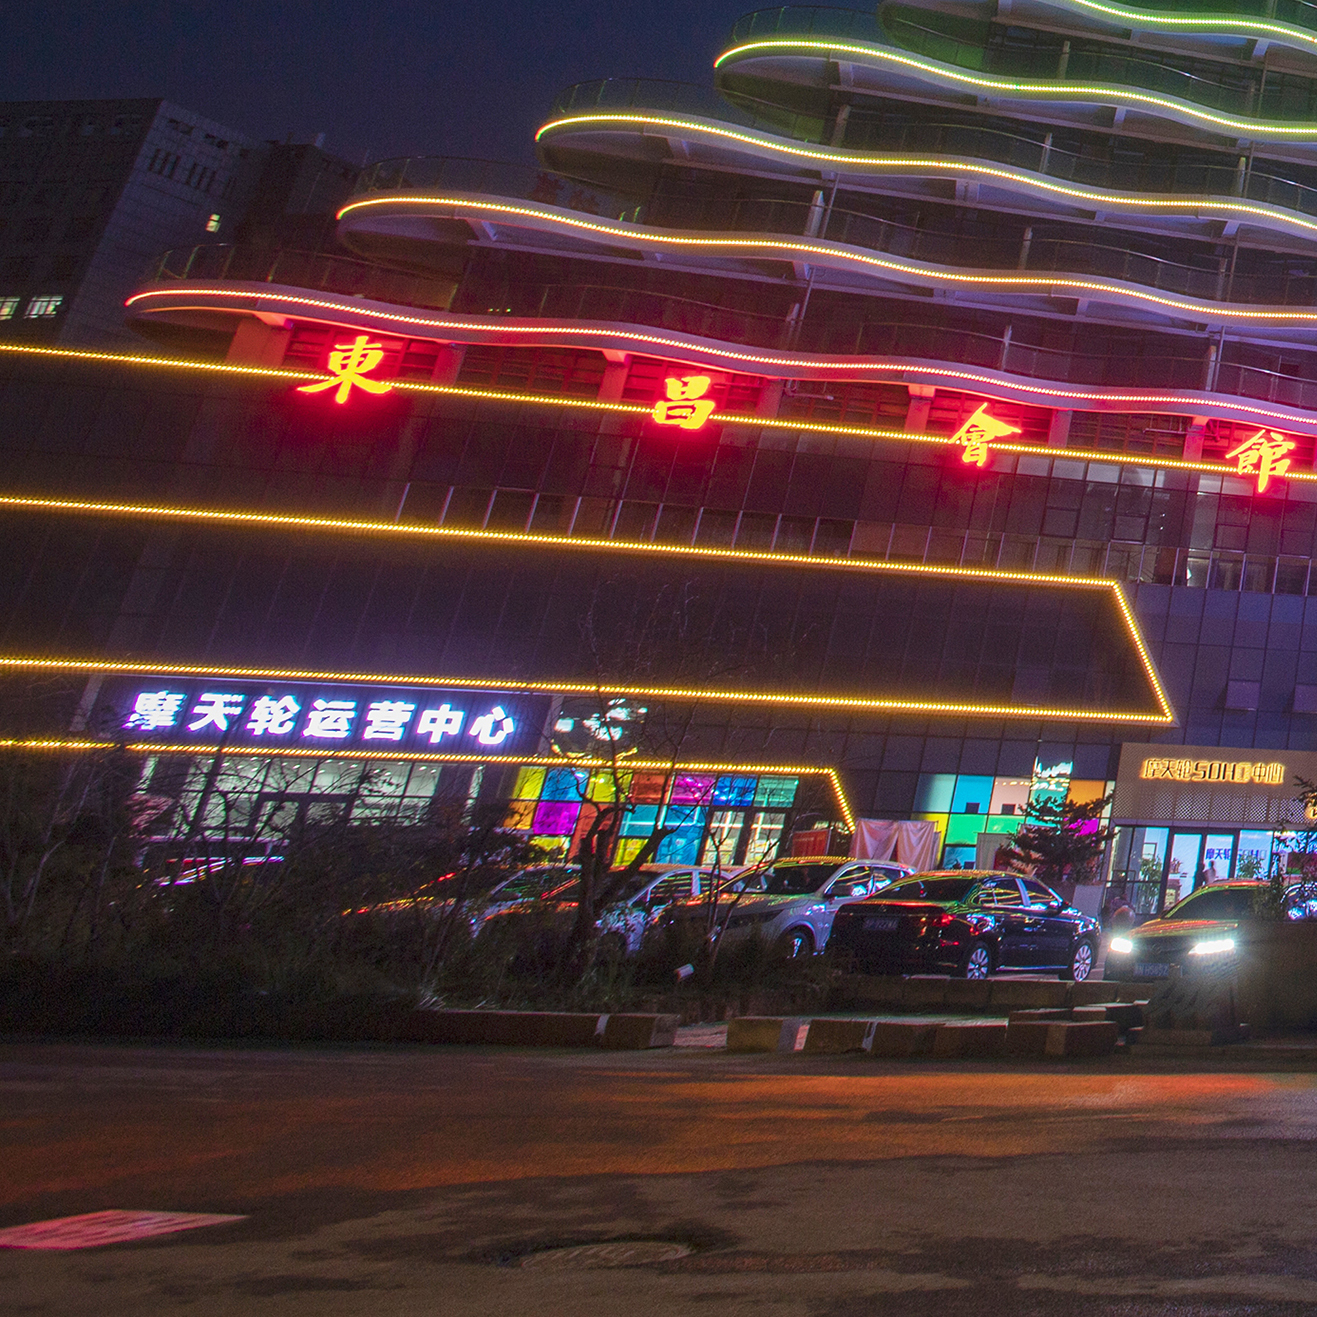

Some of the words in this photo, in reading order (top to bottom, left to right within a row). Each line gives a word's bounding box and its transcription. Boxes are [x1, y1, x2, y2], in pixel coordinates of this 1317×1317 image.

[122, 690, 516, 746] 摩天轮运营中心
